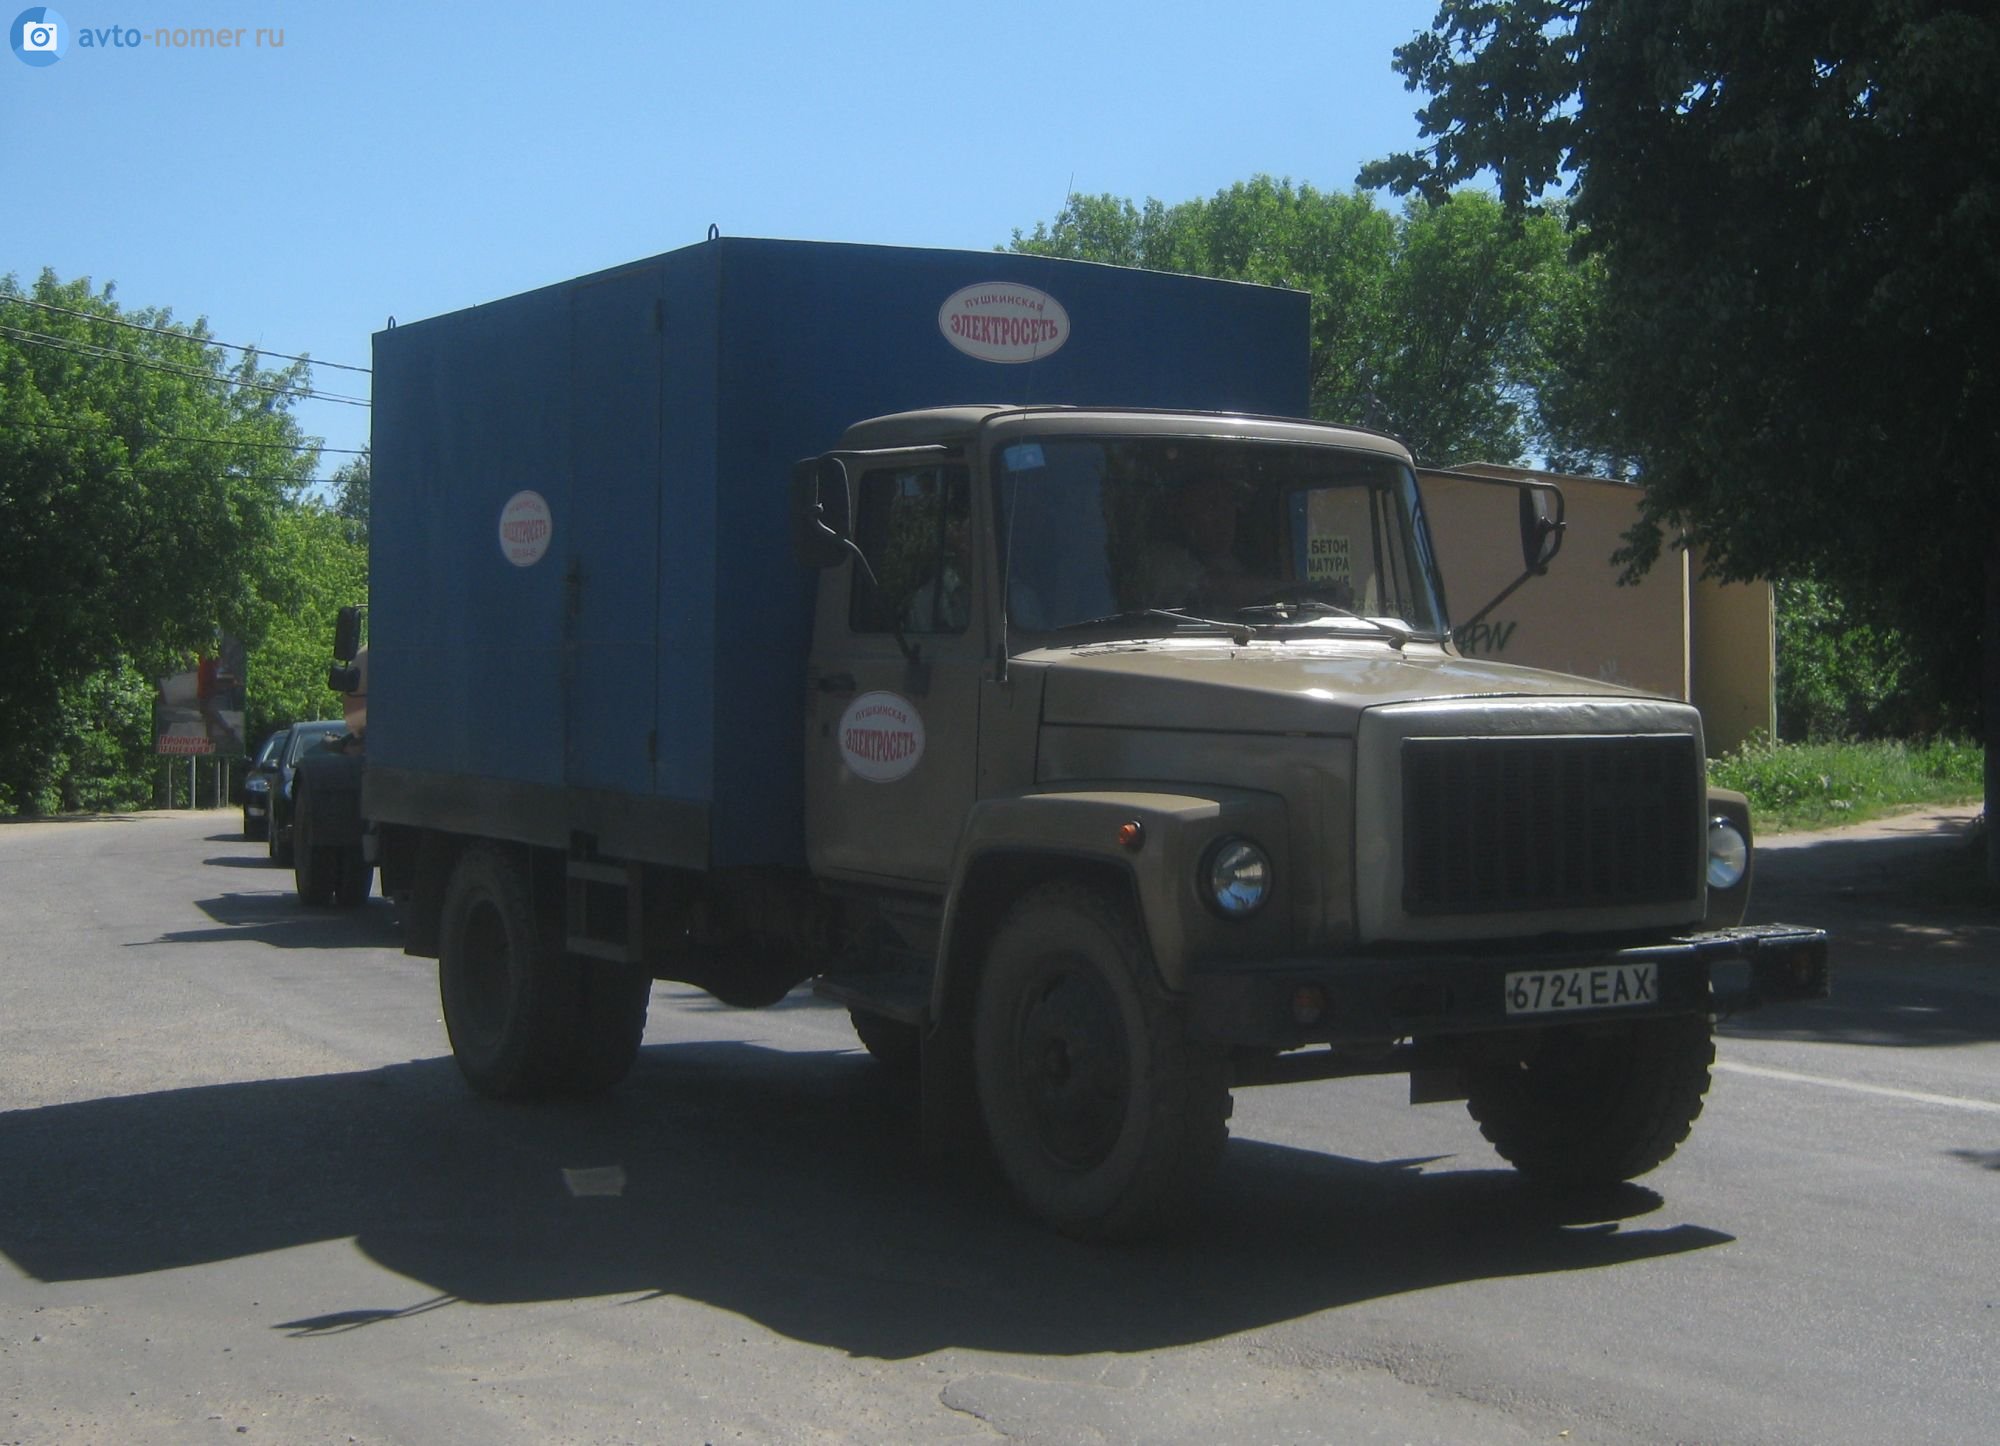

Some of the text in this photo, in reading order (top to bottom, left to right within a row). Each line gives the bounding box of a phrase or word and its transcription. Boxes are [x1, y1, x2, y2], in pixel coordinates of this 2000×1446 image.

[965, 294, 1044, 313] ПУШКИНСКАЯ
[950, 314, 1059, 346] ЭЛЕКТРОСЕТЬ
[1311, 539, 1348, 554] БЕТОН
[855, 704, 907, 724] ПУШКИНСКАЯ
[846, 728, 916, 762] ЭЛЕКТРОСЕТЬ
[1513, 967, 1650, 1009] 6724ЕАХ
